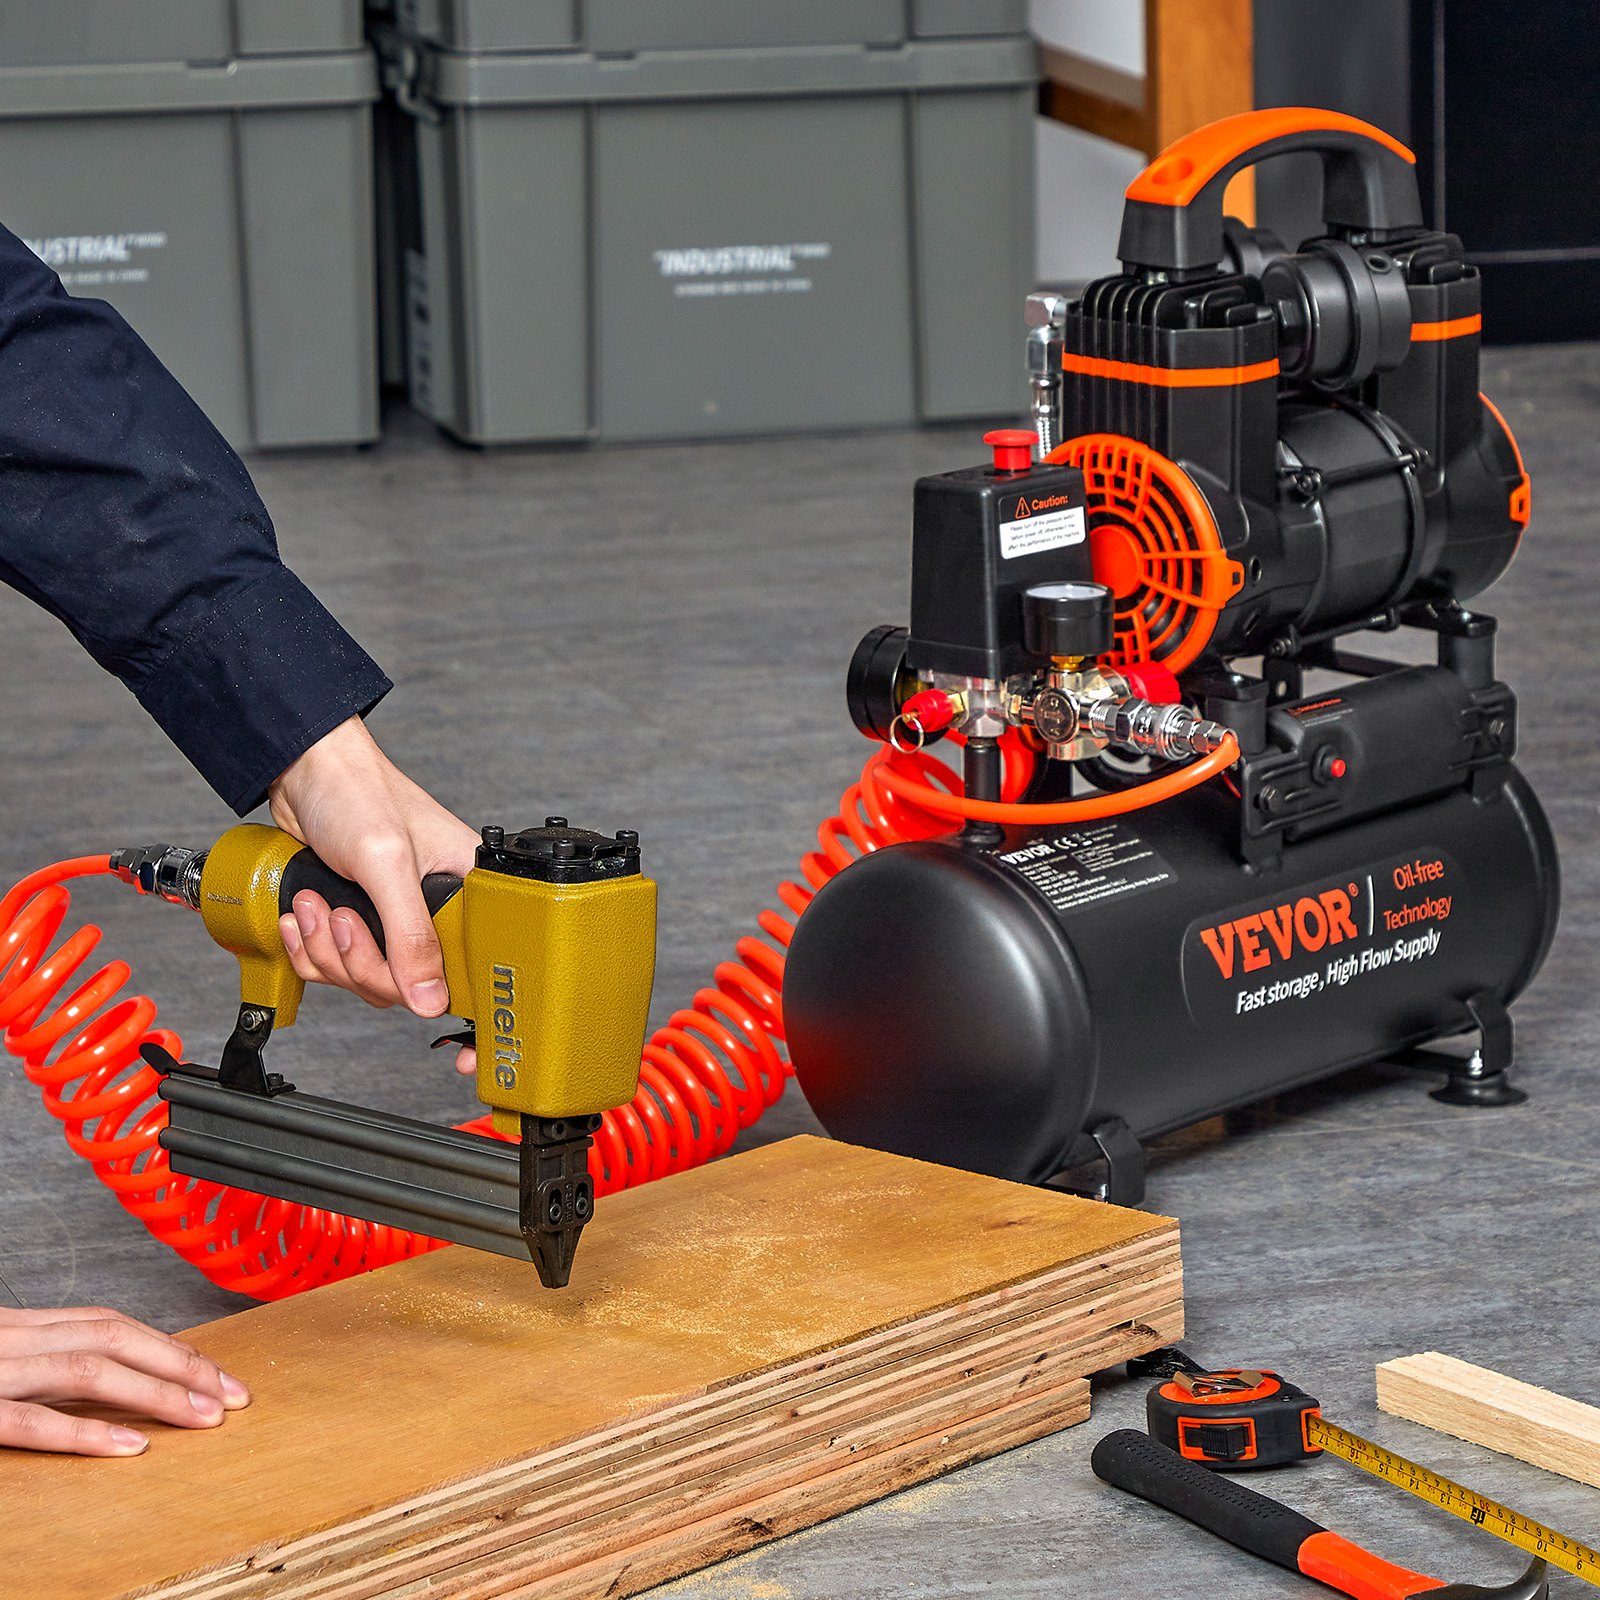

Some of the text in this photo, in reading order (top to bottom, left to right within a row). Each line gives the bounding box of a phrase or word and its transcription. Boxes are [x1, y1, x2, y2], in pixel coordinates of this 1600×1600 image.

[1031, 495, 1068, 510] Caution:
[1000, 844, 1056, 865] VEVOR
[1392, 860, 1445, 891] Oil-free
[1383, 895, 1452, 931] Technology
[1236, 990, 1267, 1015] Fast
[1327, 954, 1359, 986] High
[1360, 944, 1394, 973] Flow
[1395, 927, 1441, 963] Supply
[493, 964, 522, 1090] meite
[1318, 1434, 1583, 1570] 9 10 11 1F 13 14 15 16 17
[1480, 1499, 1490, 1512] 30
[1524, 1521, 1529, 1531] 7
[1576, 1546, 1581, 1556] 3
